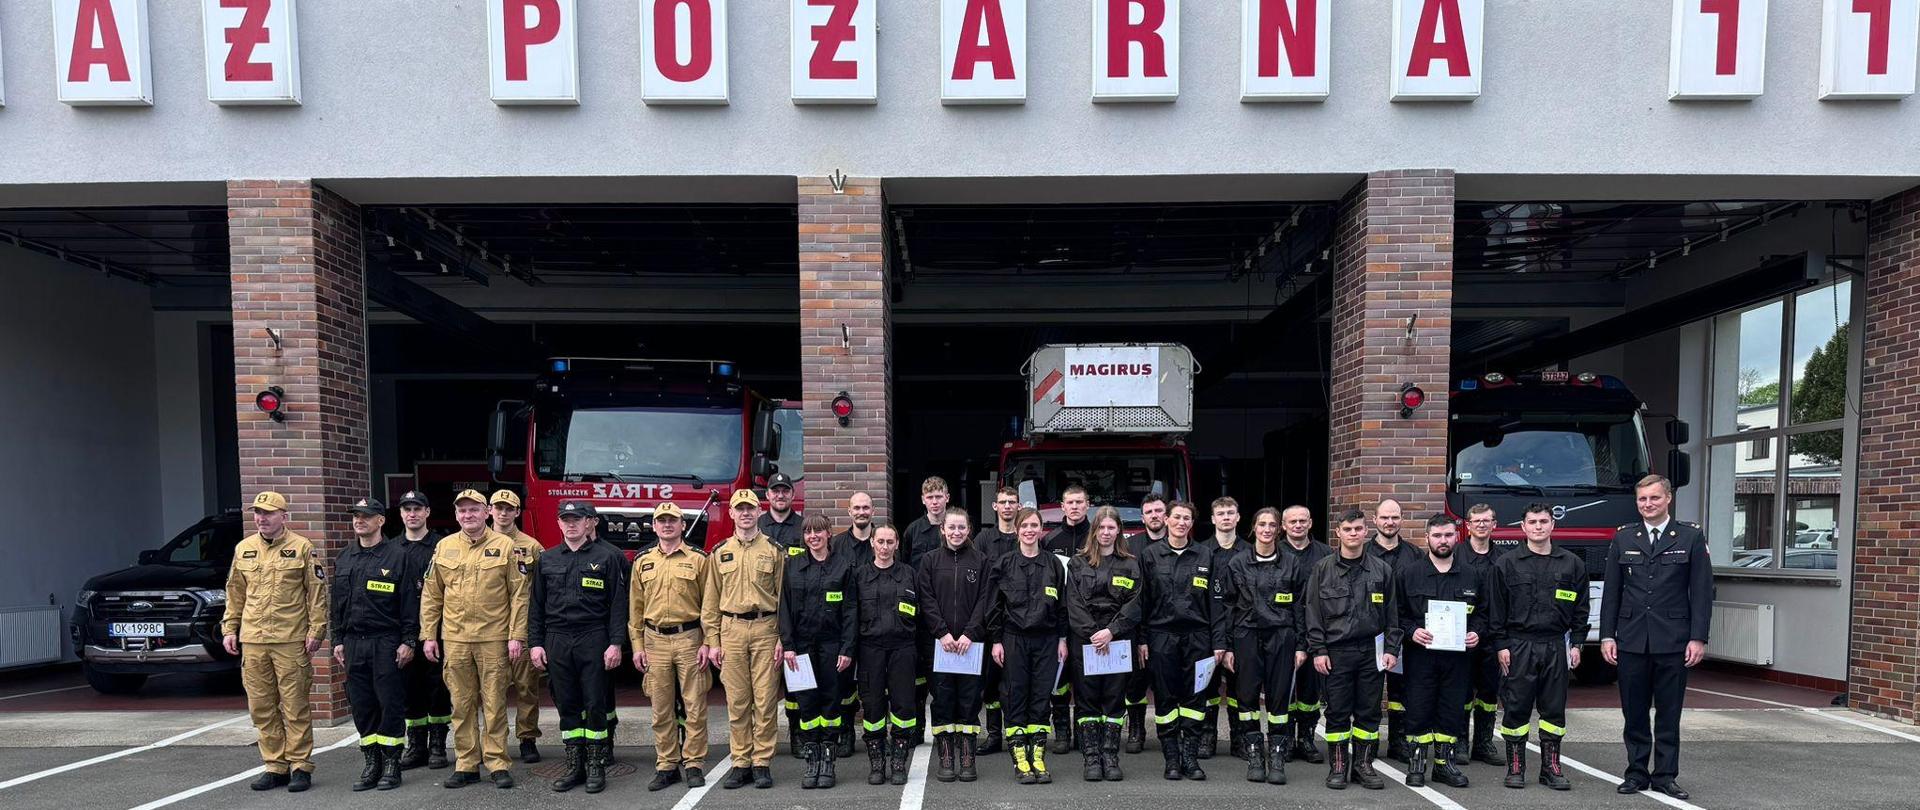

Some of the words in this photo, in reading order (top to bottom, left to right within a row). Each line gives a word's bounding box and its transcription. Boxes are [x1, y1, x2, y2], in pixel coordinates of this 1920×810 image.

[1070, 363, 1152, 376] MAGIRUS
[548, 489, 589, 497] STOLARCZYK
[115, 624, 128, 634] OK
[132, 624, 162, 634] 1998C
